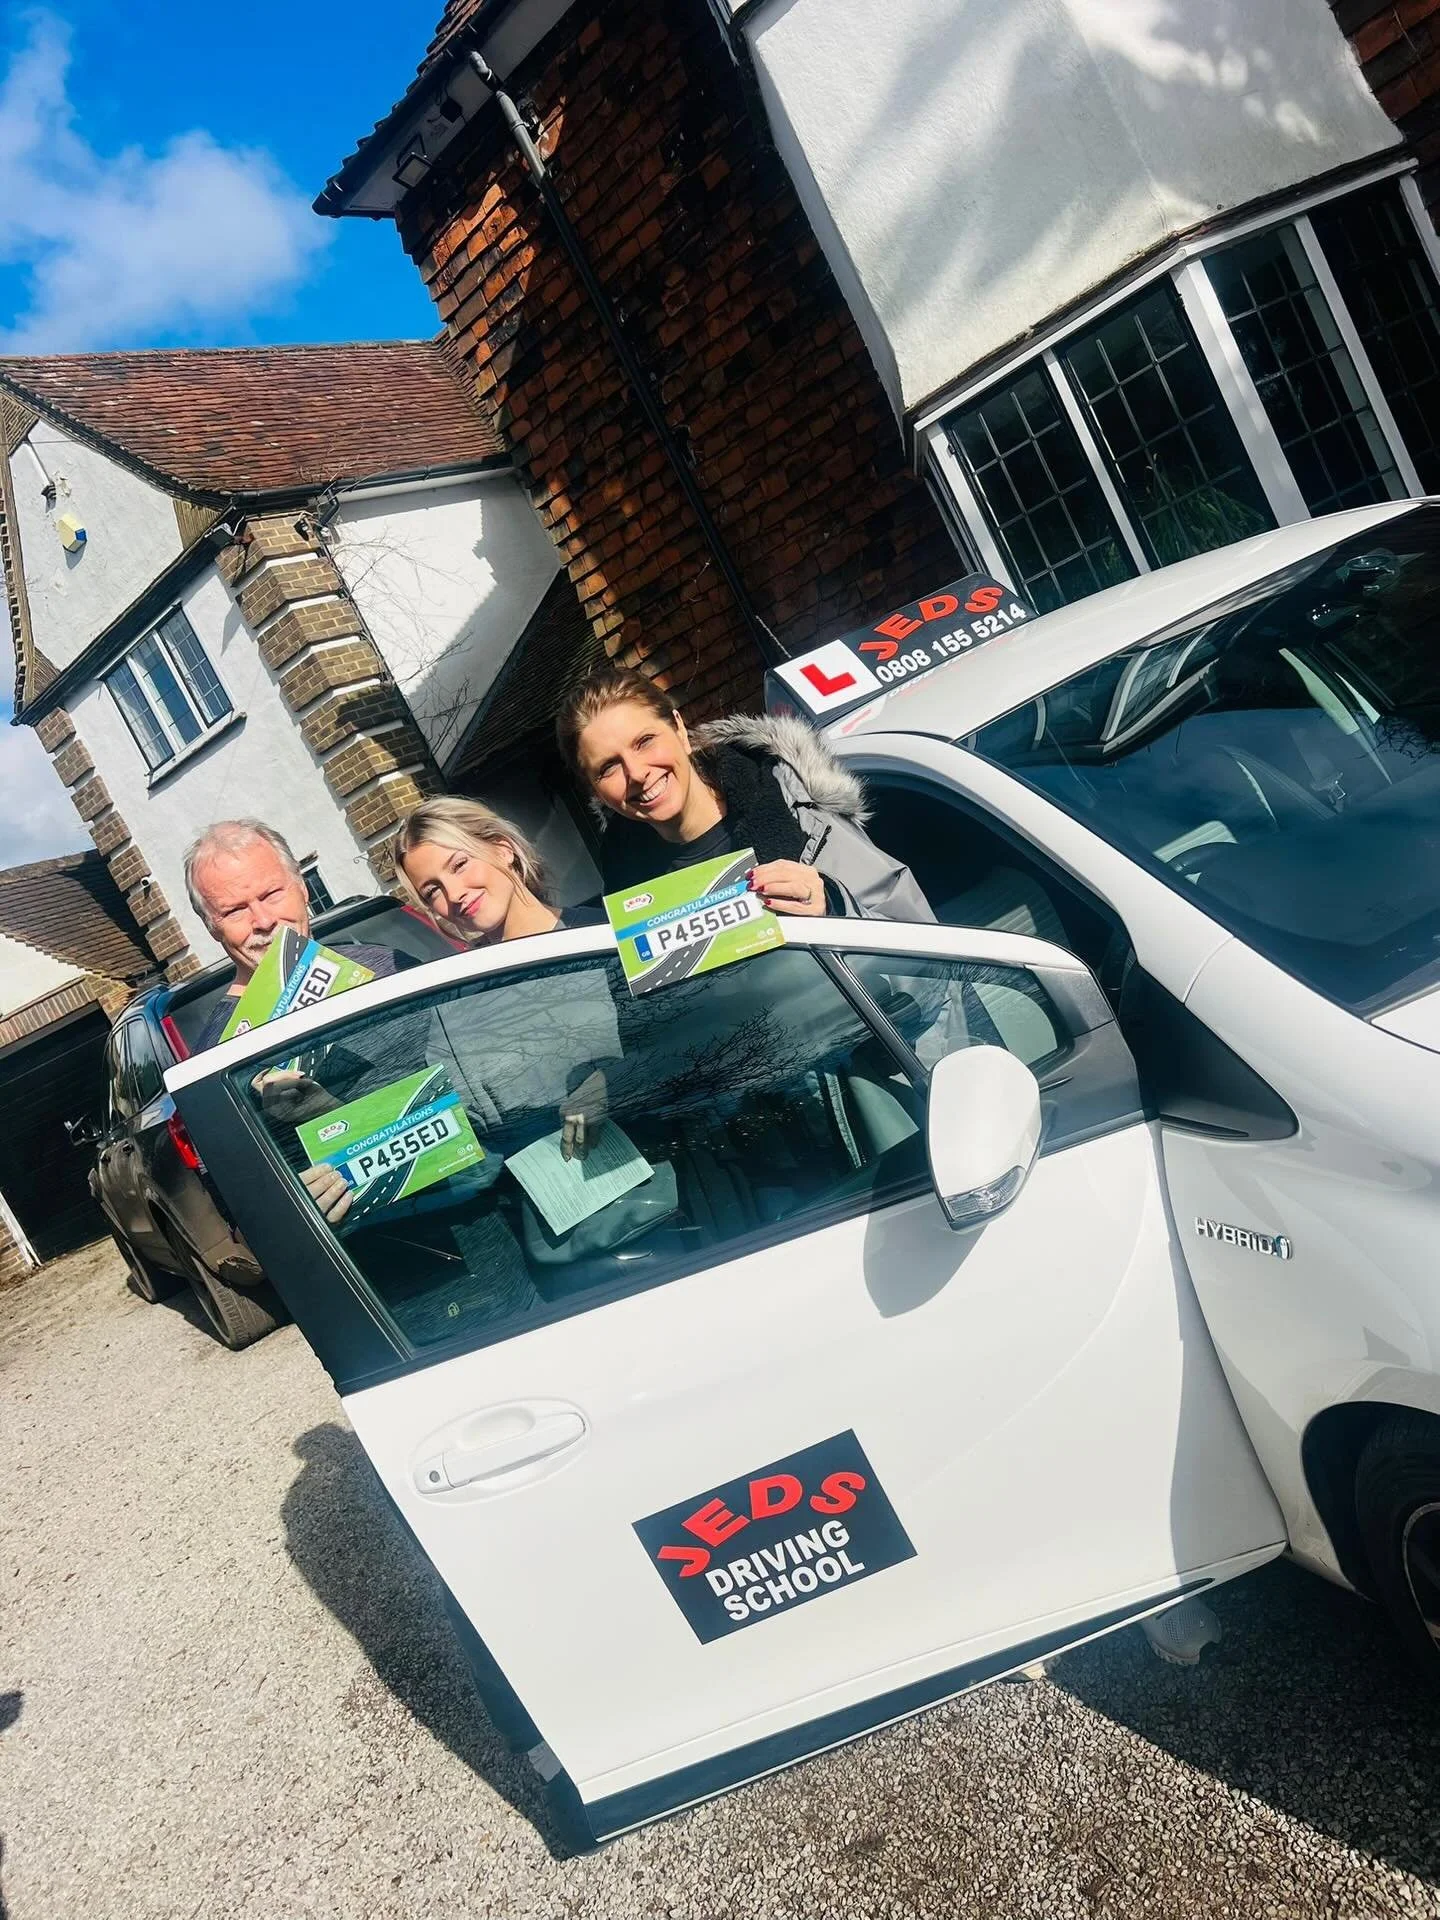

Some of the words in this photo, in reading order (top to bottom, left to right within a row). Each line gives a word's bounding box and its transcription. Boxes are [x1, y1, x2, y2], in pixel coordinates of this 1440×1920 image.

[858, 586, 1004, 661] JEDS
[876, 649, 932, 683] 0808
[932, 630, 973, 658] 155
[970, 603, 1027, 639] 5214
[799, 663, 857, 697] L
[646, 886, 738, 928] CONGRATULATIONS
[657, 900, 751, 950] P455ED
[346, 1106, 434, 1156] CONGRATULATIONS
[358, 1118, 450, 1178] P455ED
[1194, 1216, 1273, 1255] HYBRID
[656, 1471, 867, 1578] JEDS
[704, 1520, 850, 1597] DRIVING
[723, 1550, 866, 1621] SCHOOL
